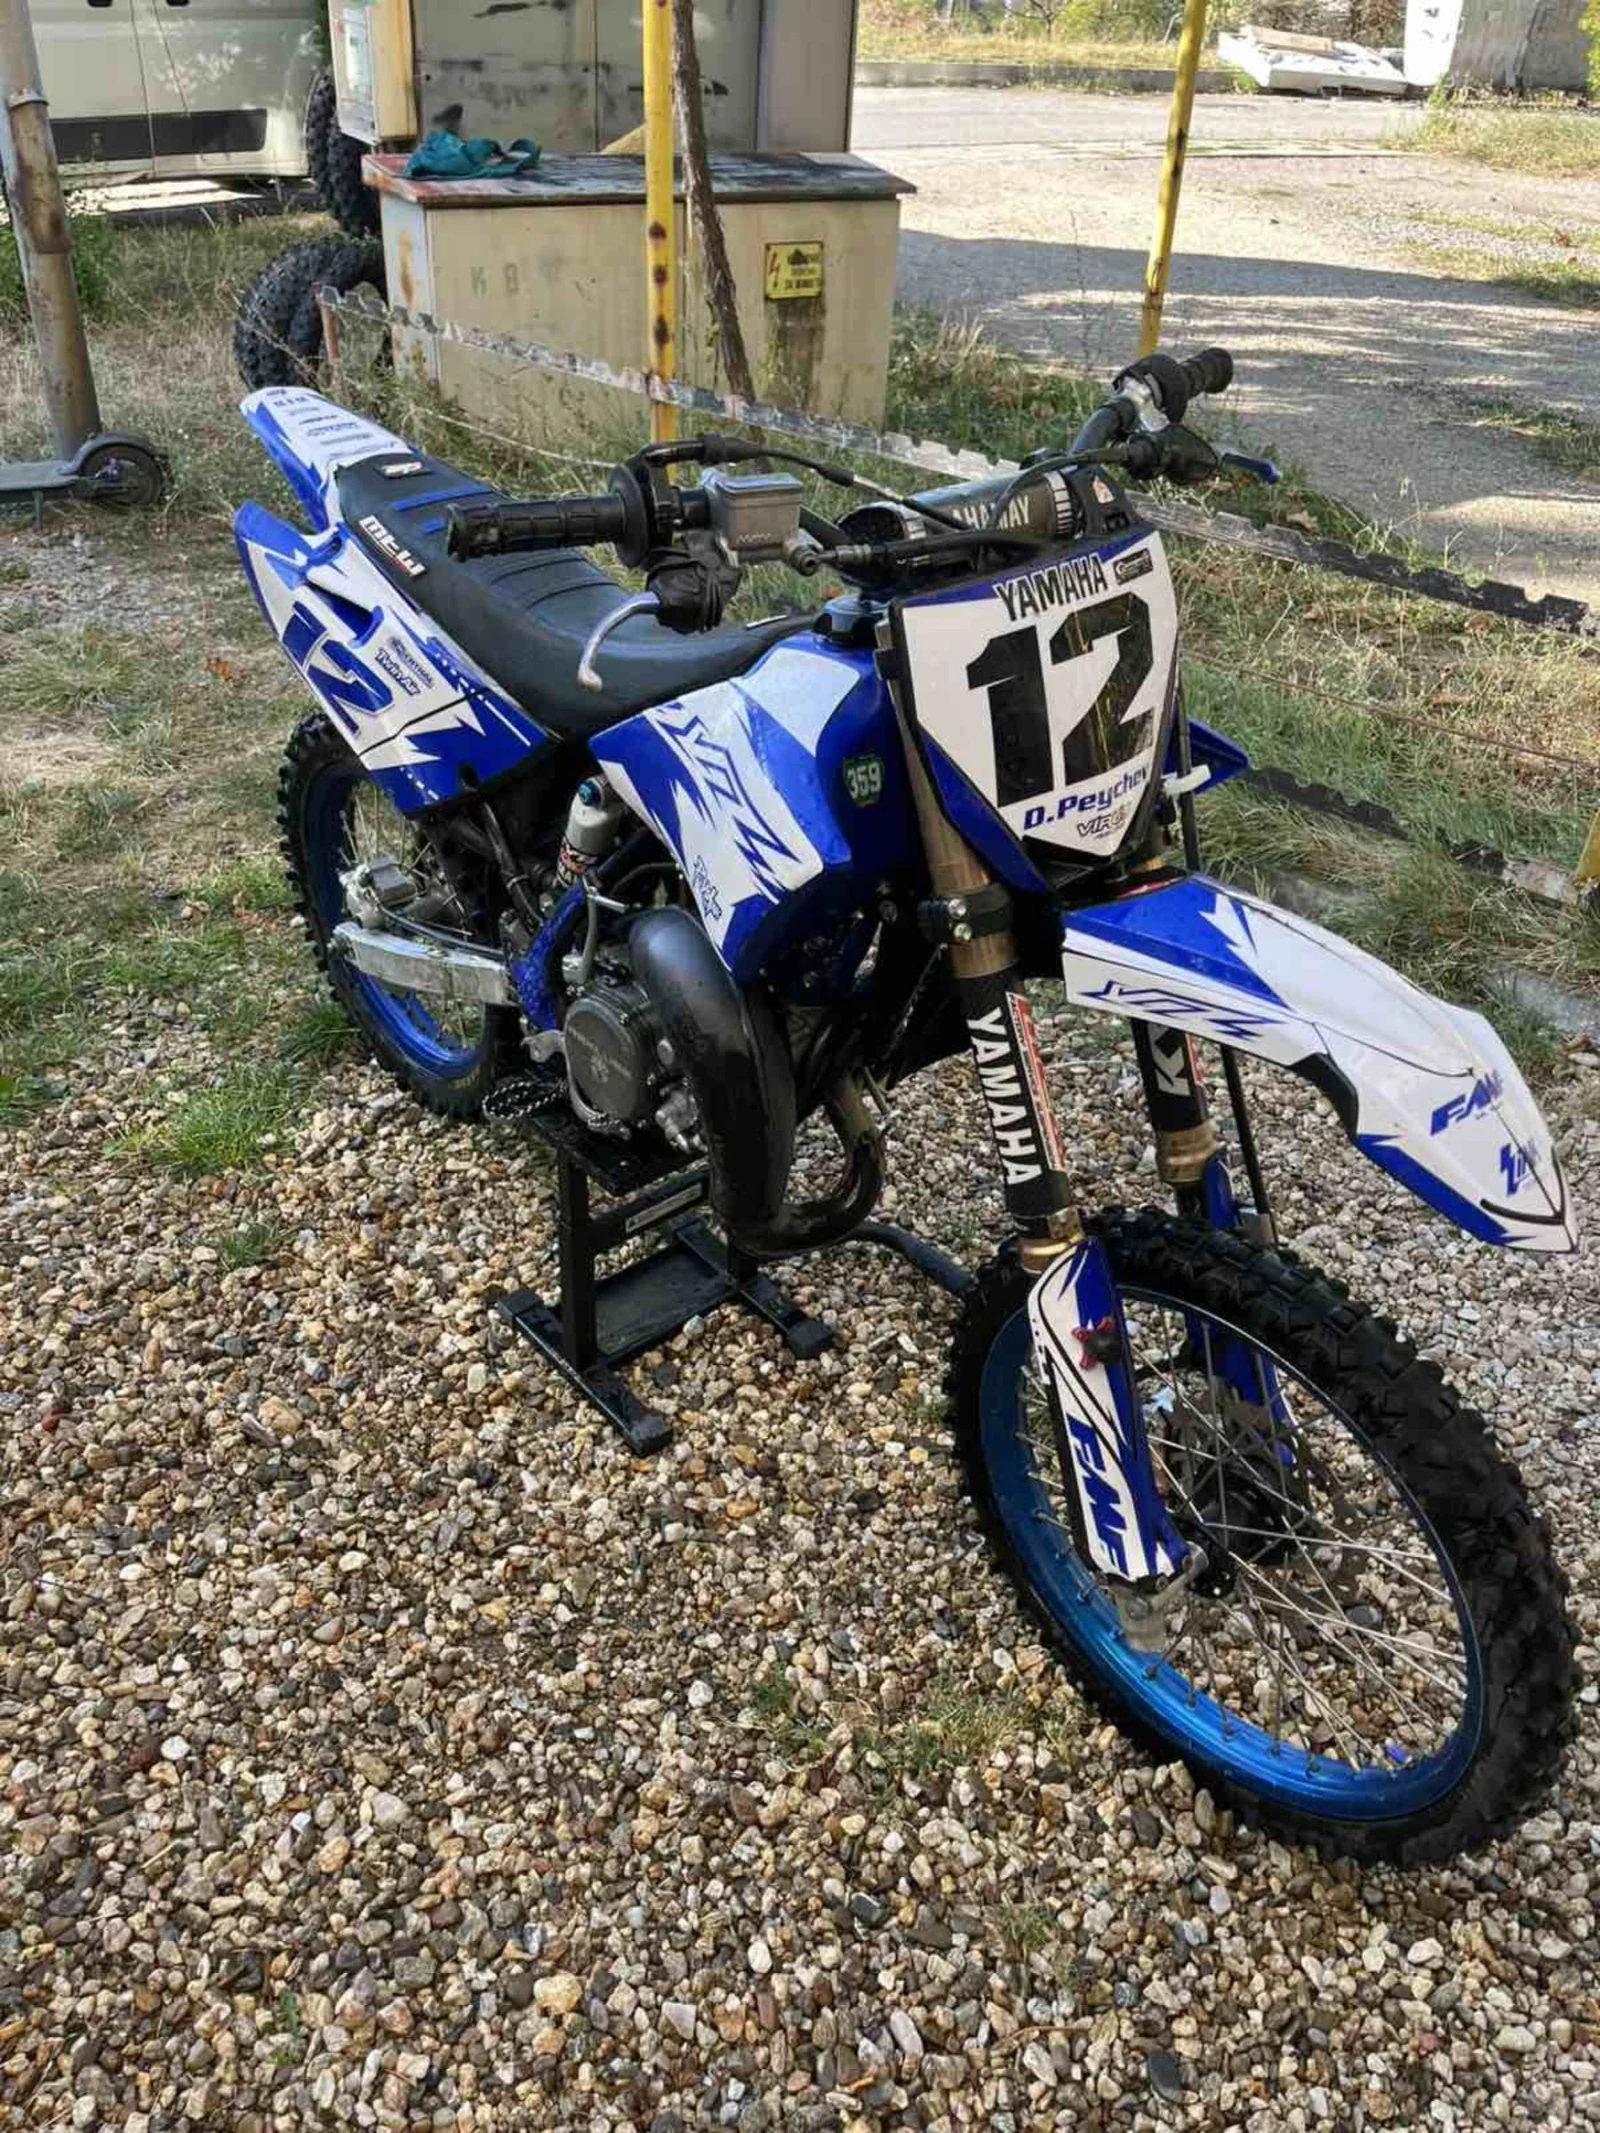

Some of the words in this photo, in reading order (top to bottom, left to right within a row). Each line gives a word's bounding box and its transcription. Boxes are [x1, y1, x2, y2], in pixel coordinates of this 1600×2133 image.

[994, 553, 1108, 621] YAMAHA
[966, 591, 1154, 807] 12
[848, 762, 881, 799] 359
[966, 1006, 1042, 1185] YAMAHA
